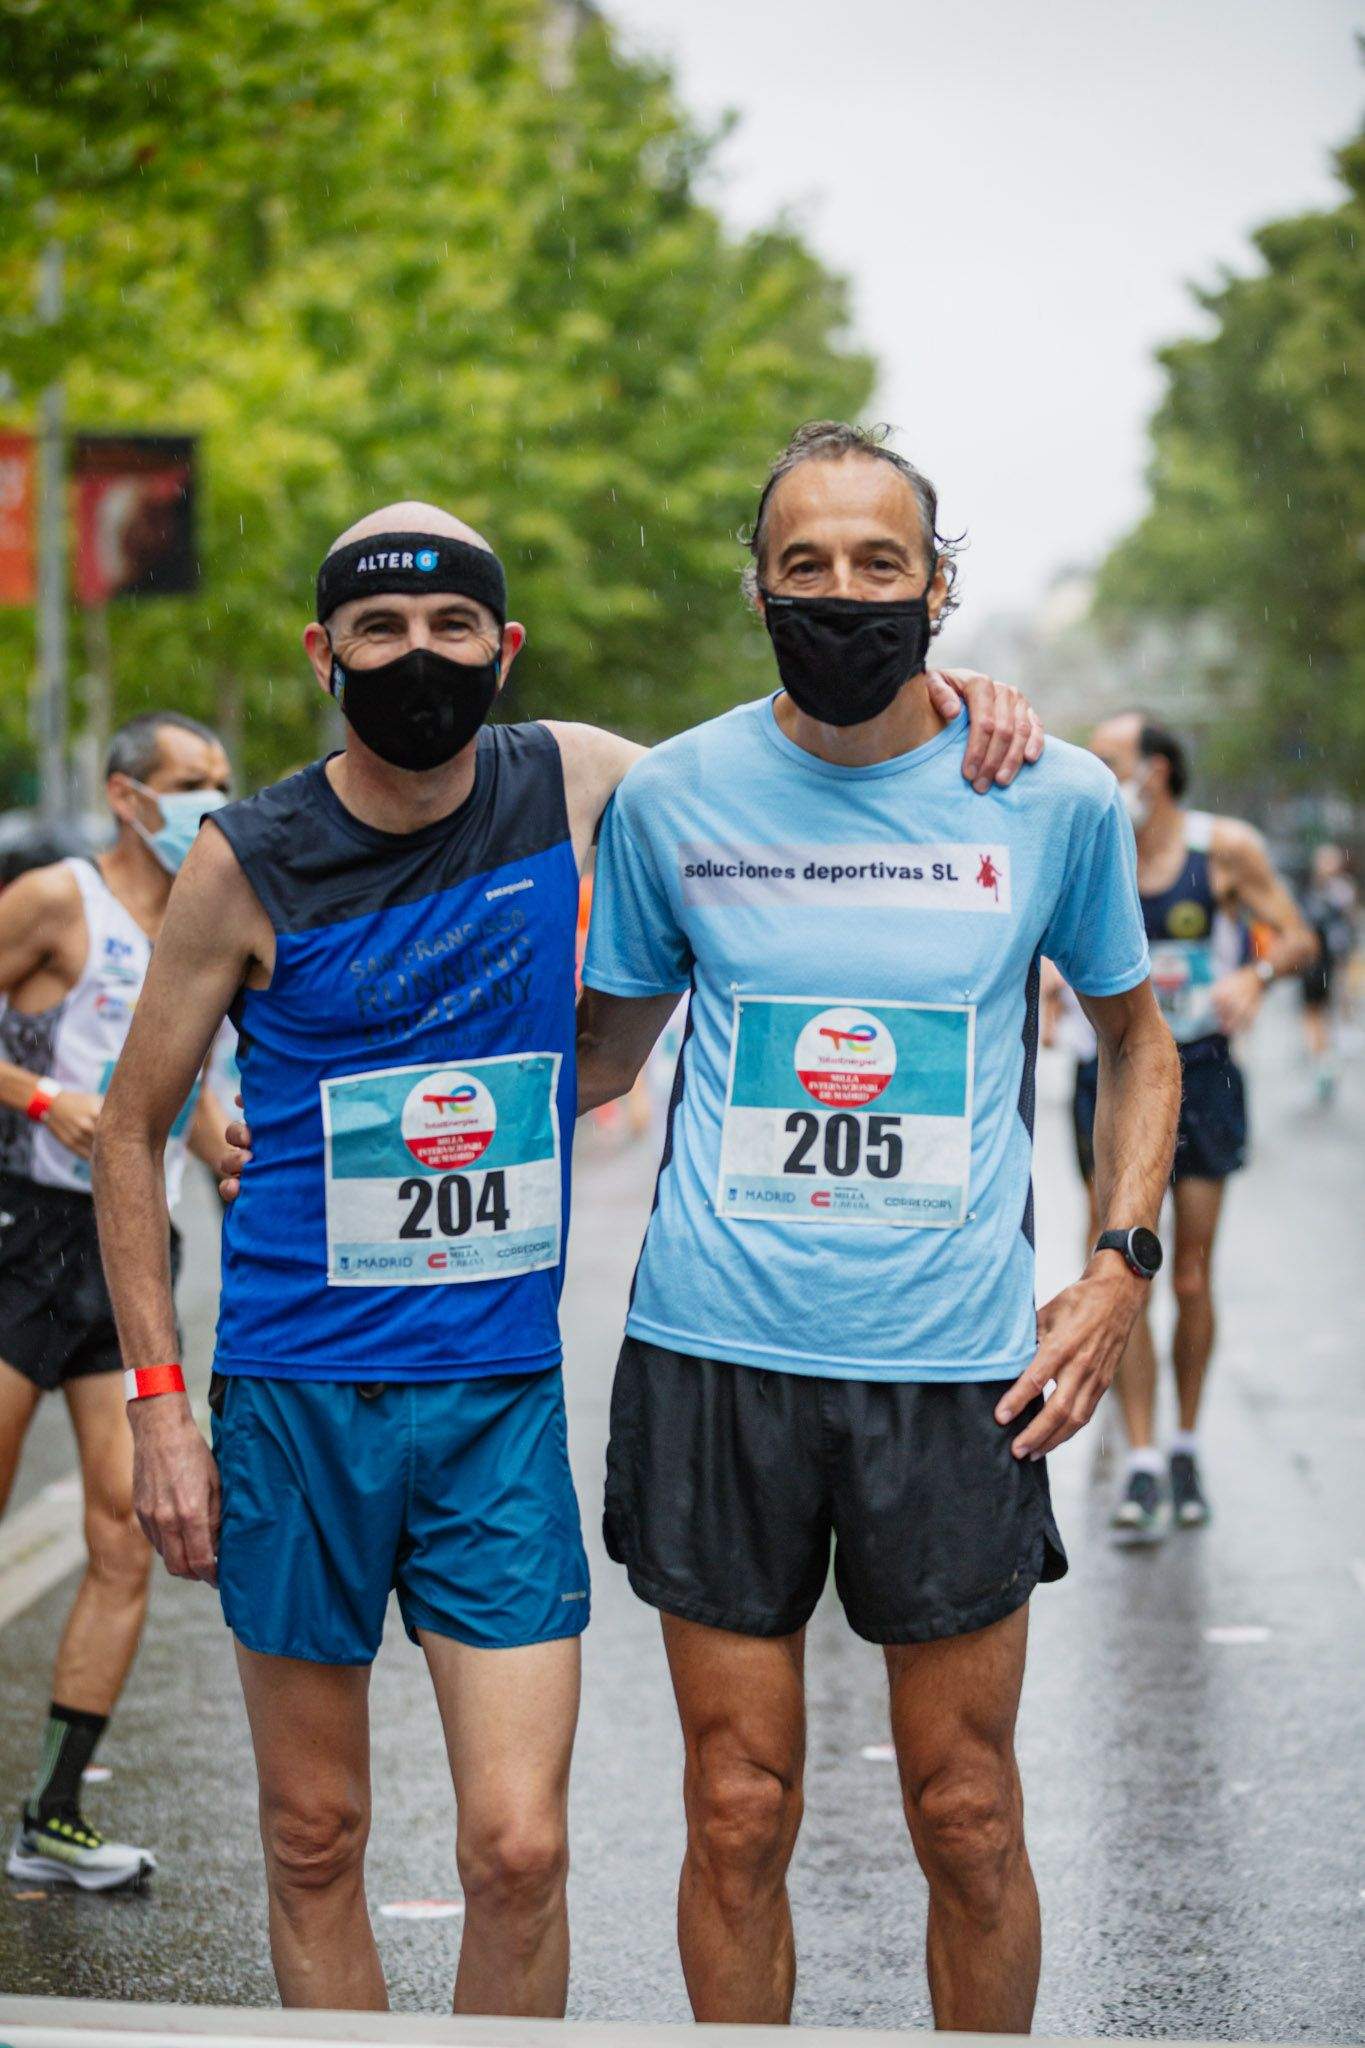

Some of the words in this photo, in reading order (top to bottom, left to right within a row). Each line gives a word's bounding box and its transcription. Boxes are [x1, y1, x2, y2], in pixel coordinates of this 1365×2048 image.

[684, 860, 796, 880] soluciones
[803, 861, 924, 883] deportivas
[932, 863, 959, 881] SL
[783, 1111, 903, 1179] 205
[397, 1170, 511, 1240] 204
[745, 1190, 796, 1203] MADRID
[356, 1255, 413, 1269] MADRID
